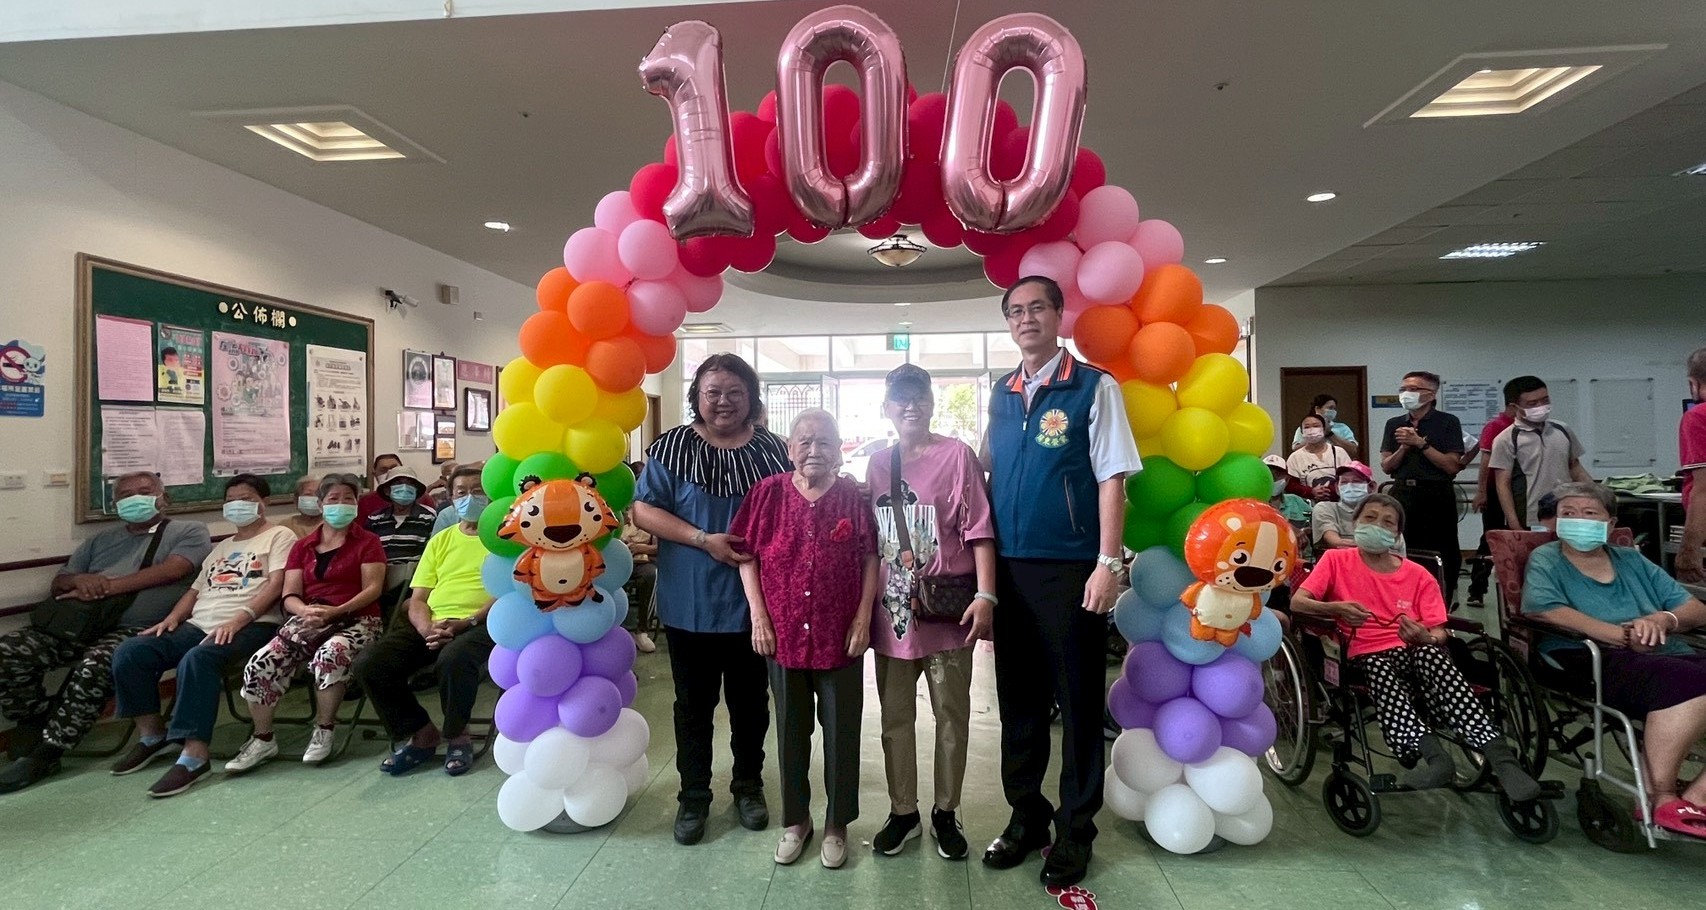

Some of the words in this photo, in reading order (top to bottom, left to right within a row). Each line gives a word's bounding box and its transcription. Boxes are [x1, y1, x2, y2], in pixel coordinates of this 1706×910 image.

[638, 4, 1088, 240] 100
[231, 302, 286, 329] 公佈欄
